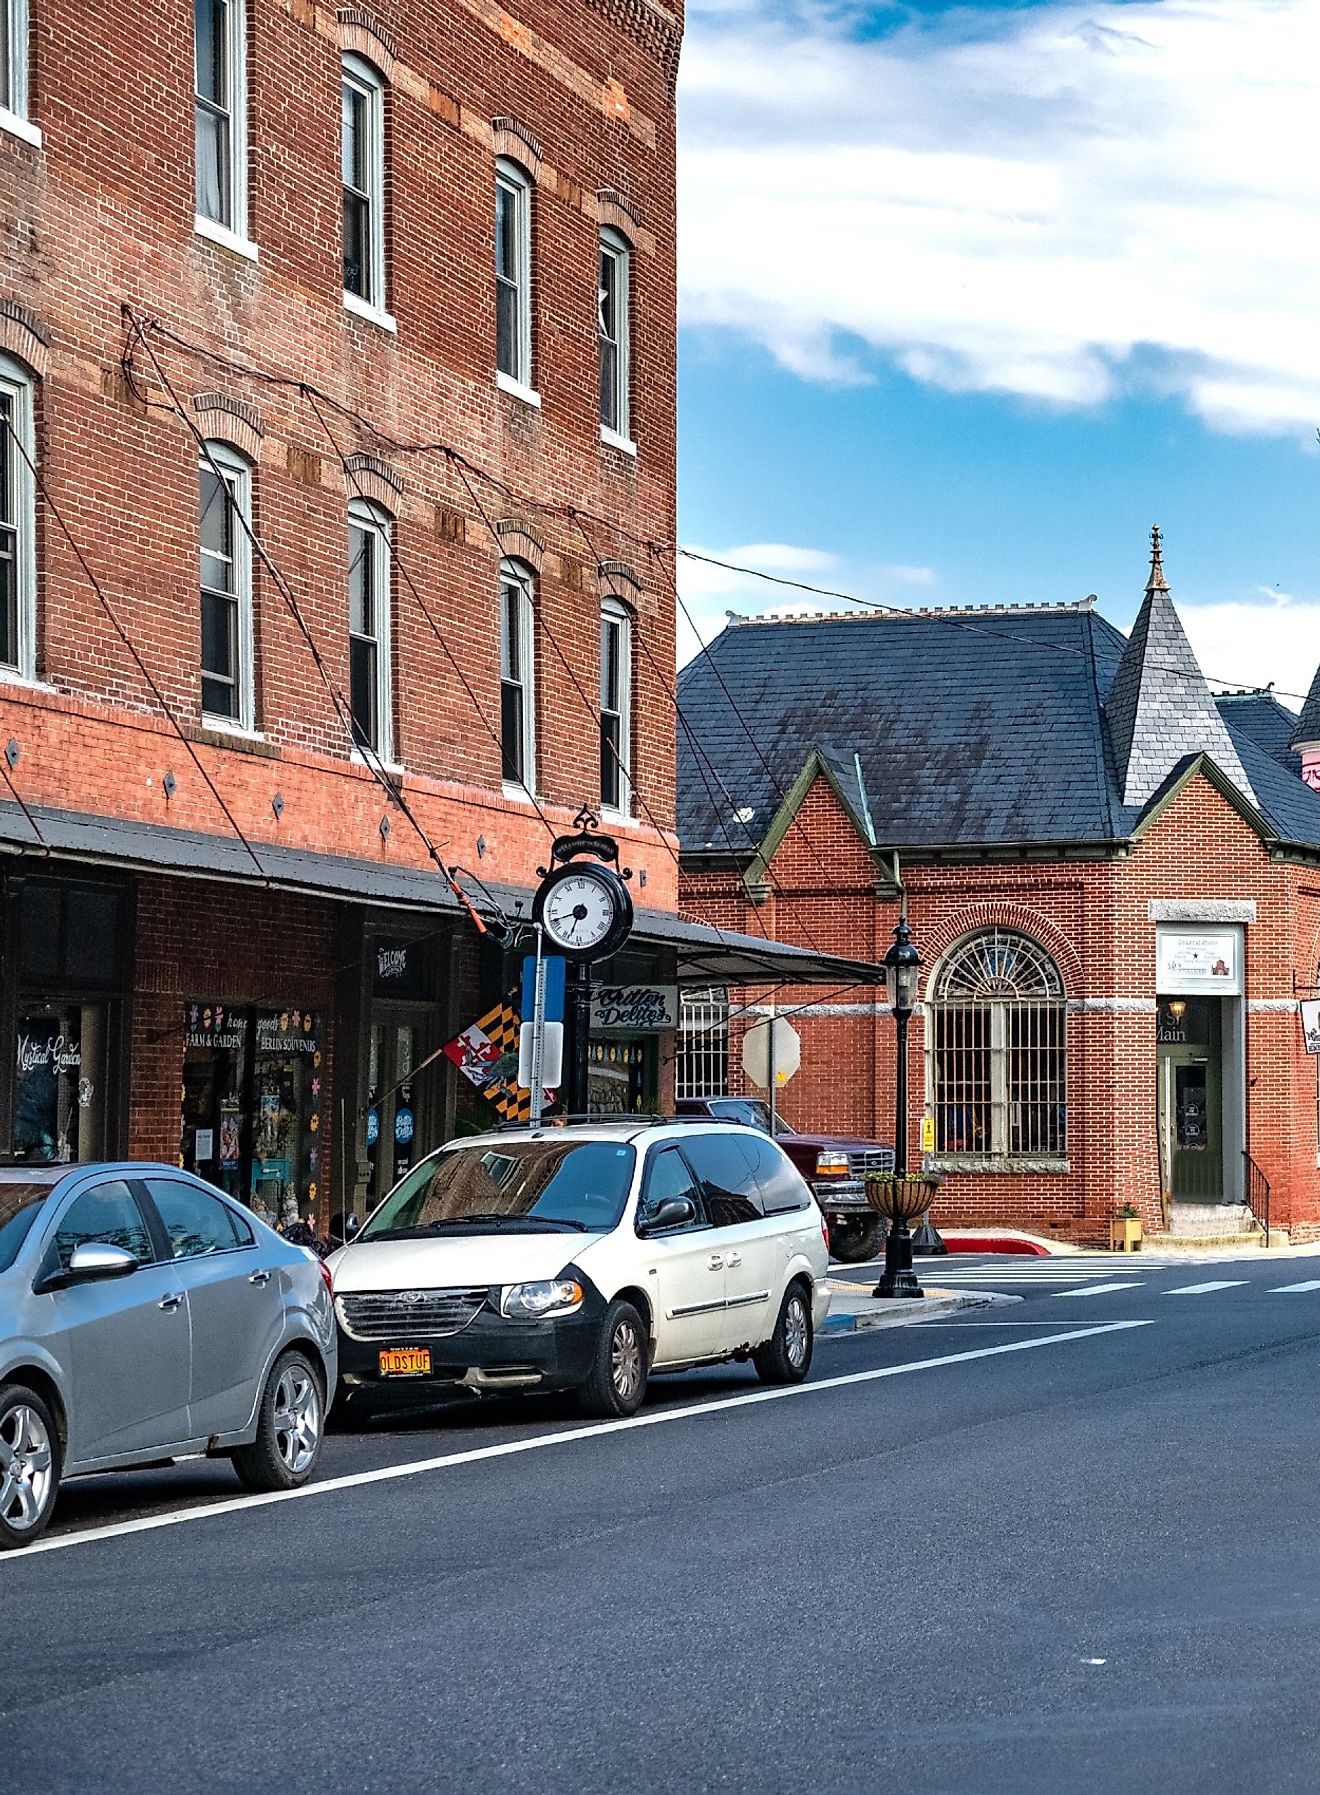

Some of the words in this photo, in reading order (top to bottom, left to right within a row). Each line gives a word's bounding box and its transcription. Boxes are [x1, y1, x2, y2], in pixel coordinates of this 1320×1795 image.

[185, 1033, 206, 1048] FARM
[213, 1034, 242, 1049] GARDEN
[261, 1036, 283, 1051] BERLIN
[17, 1034, 50, 1071] Mystical
[48, 1035, 81, 1075] Garden
[380, 1354, 429, 1370] OLDSTUF
